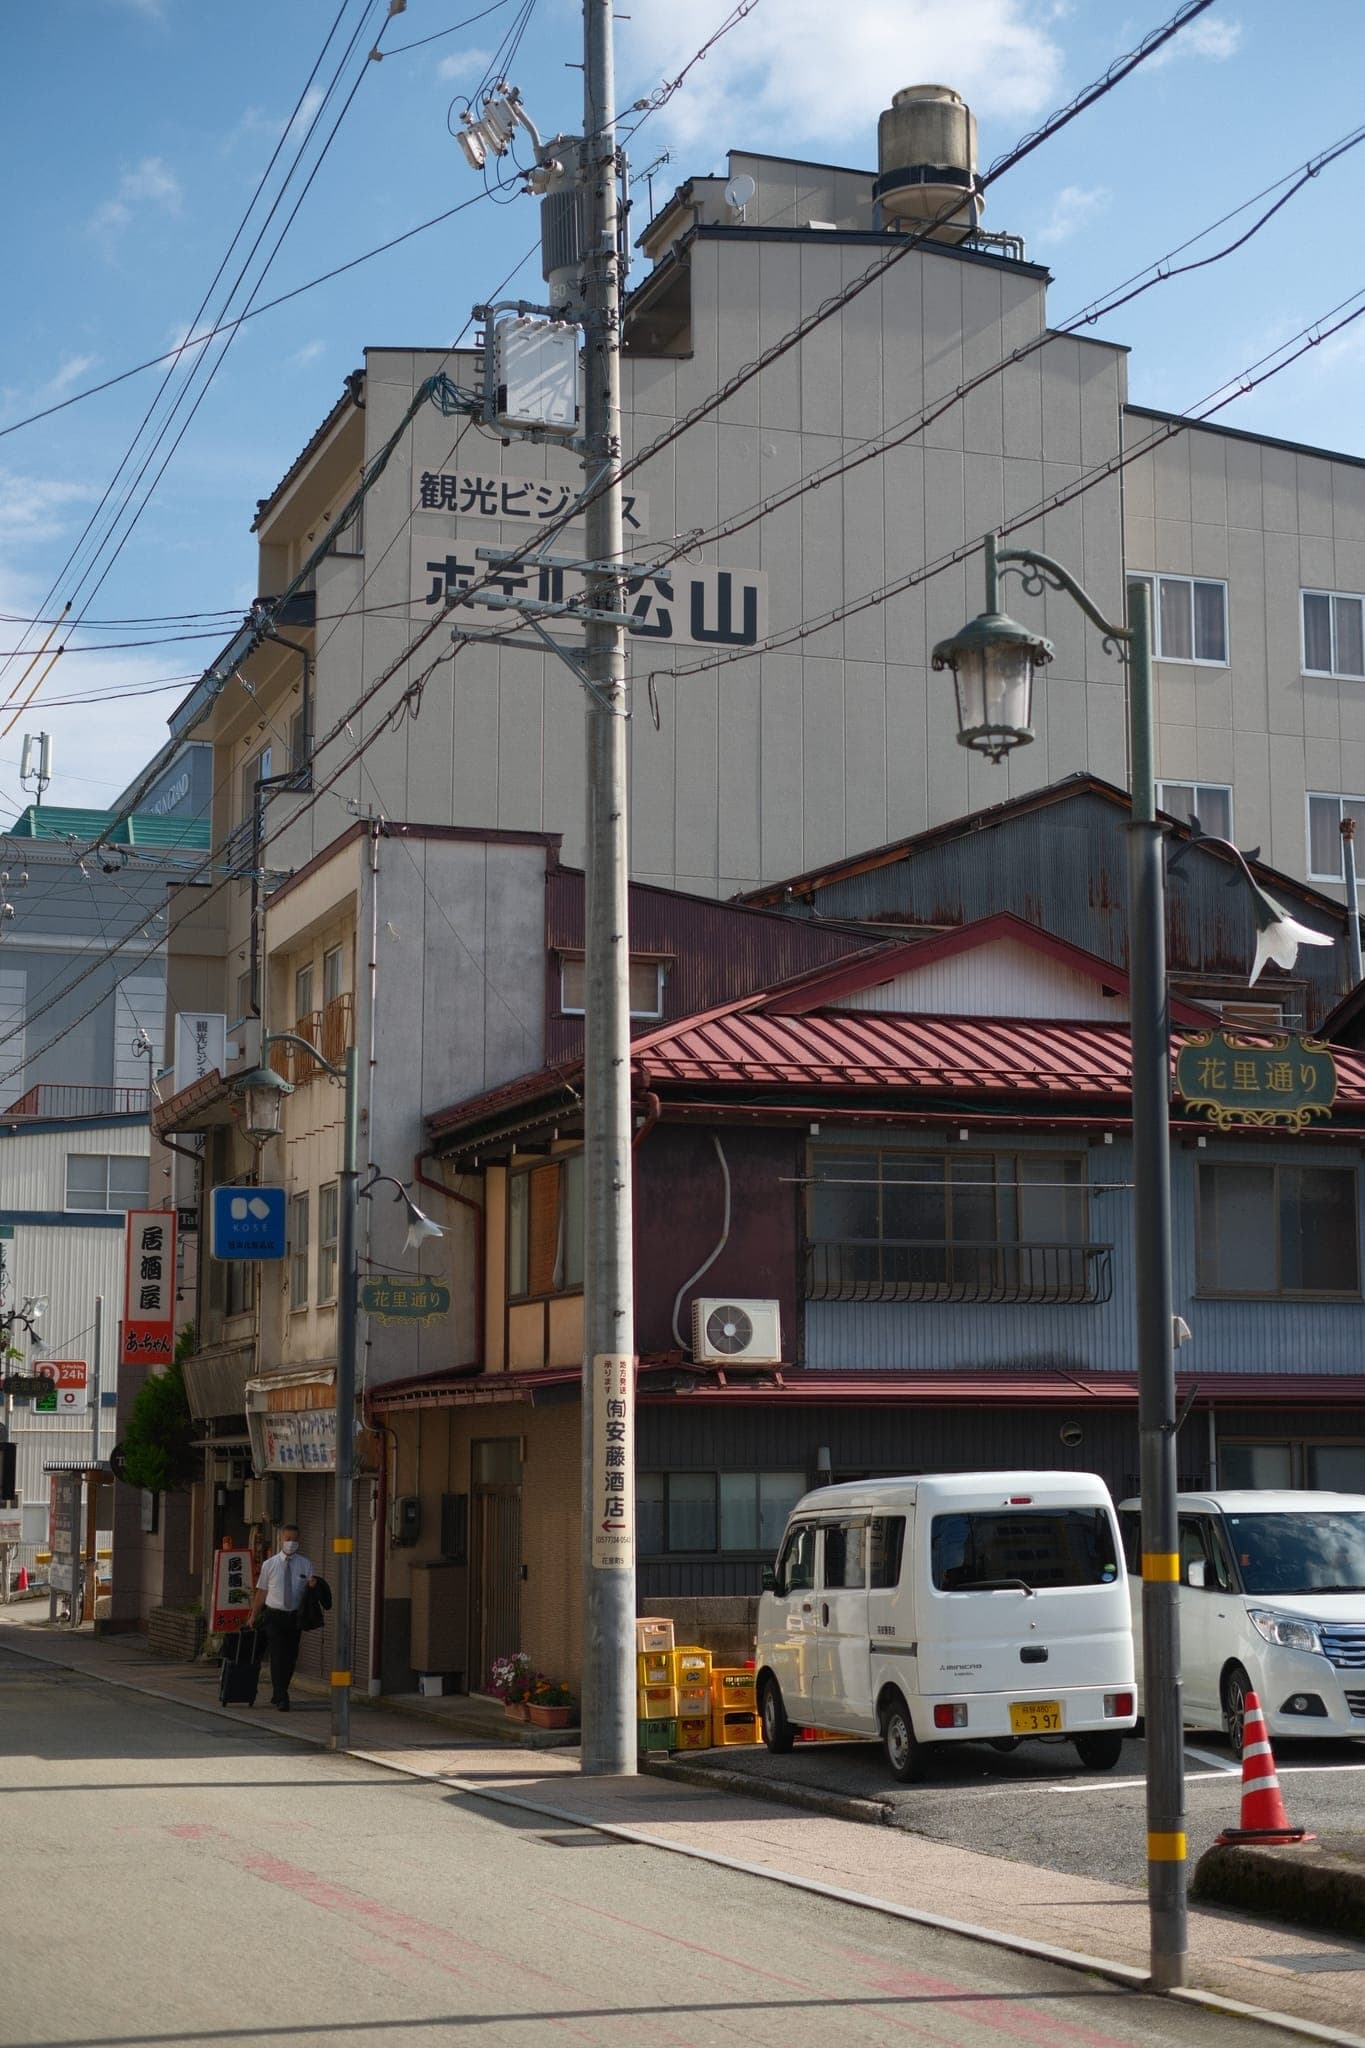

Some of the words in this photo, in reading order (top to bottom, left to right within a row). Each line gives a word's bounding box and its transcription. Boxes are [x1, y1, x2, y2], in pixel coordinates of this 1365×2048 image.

[420, 471, 642, 530] 観光ビジス
[1196, 1057, 1318, 1093] 花里通り
[139, 1225, 162, 1311] 居酒屋
[372, 1290, 441, 1309] 花里通り
[125, 1331, 172, 1355] あーちゃん
[62, 1369, 84, 1380] 24h
[603, 1359, 613, 1395] 承ります
